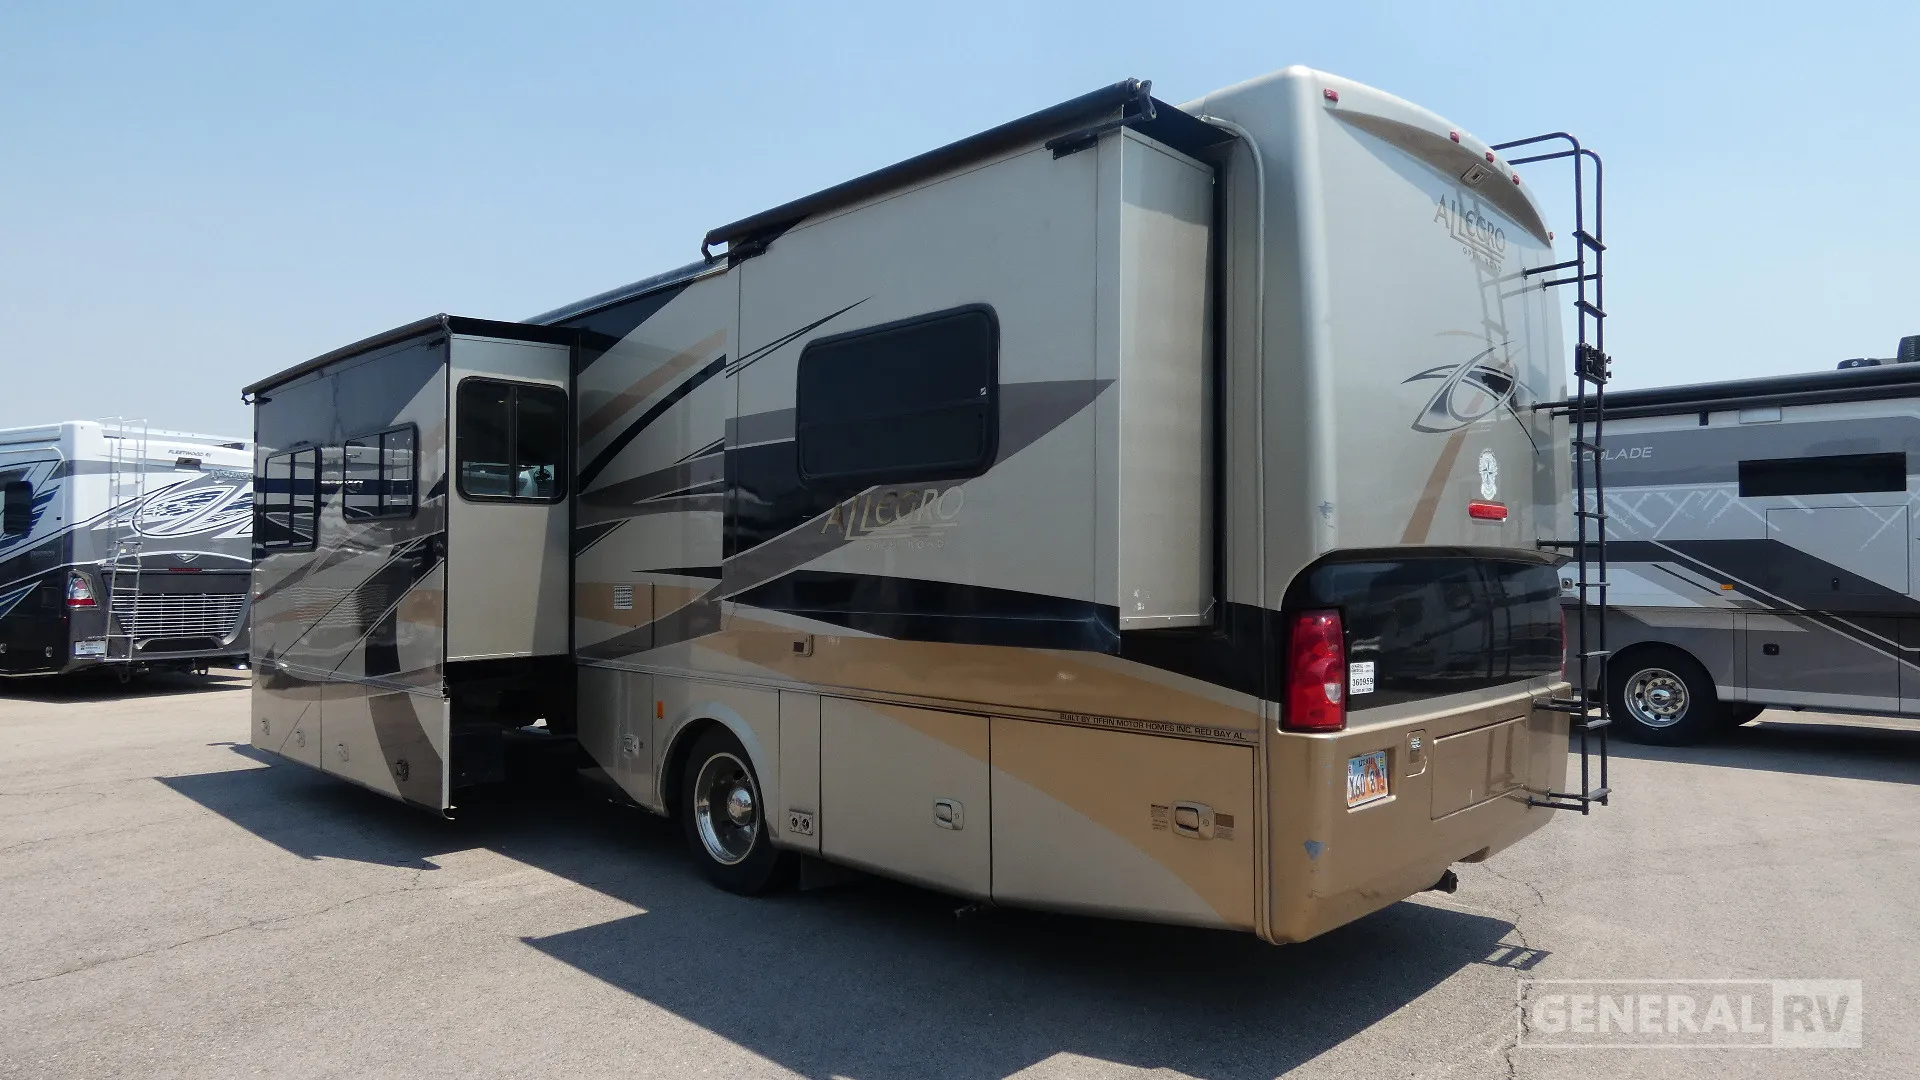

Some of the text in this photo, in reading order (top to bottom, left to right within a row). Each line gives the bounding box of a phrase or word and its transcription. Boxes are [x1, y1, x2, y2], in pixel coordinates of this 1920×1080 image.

[1433, 194, 1505, 263] ALLEGRO
[167, 449, 204, 457] FLEETWOOD
[1571, 446, 1653, 462] CCOLADE
[820, 485, 966, 541] ALLEGRO
[1060, 713, 1080, 722] BUILT
[1081, 715, 1091, 723] BY
[1116, 719, 1144, 729] MOTOR
[1146, 722, 1174, 732] HOMES
[1194, 727, 1212, 736] RED
[1213, 729, 1232, 738] BAY
